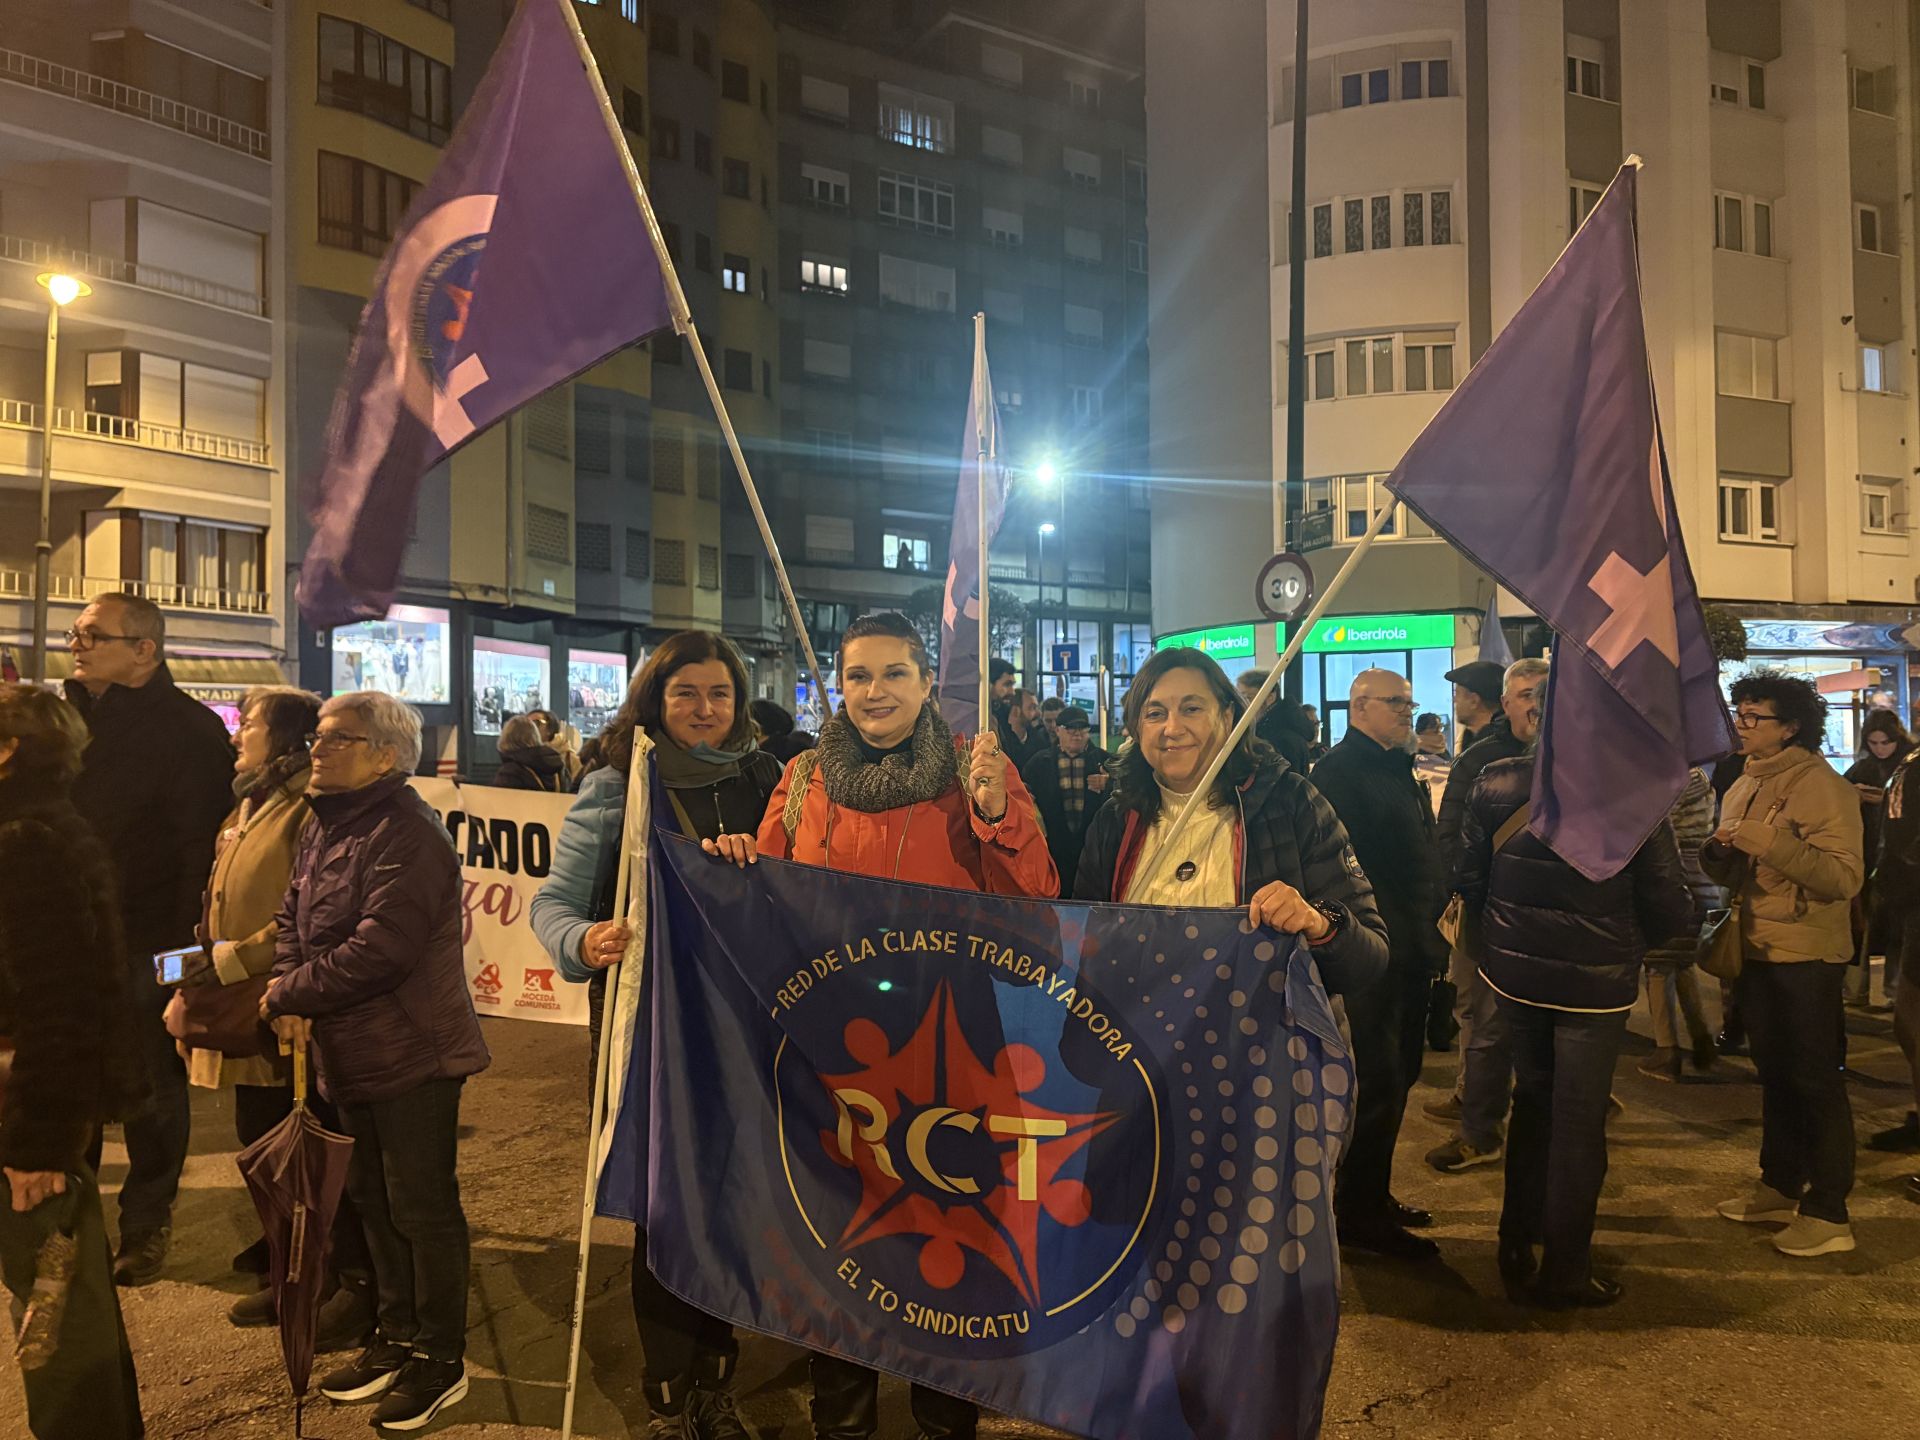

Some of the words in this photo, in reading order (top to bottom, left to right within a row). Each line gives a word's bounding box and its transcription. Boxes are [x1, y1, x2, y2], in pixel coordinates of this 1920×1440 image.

[1271, 577, 1300, 599] 30
[1206, 636, 1249, 650] Iberdrola
[1348, 627, 1407, 641] Iberdrola
[514, 1000, 561, 1010] COMUNISTA
[776, 969, 814, 1010] RED
[811, 949, 843, 979] DE
[845, 937, 877, 963] LA
[883, 930, 958, 954] CLASE
[967, 935, 1133, 1061] TRABAYADORA
[832, 1088, 1067, 1201] RCT
[837, 1257, 861, 1290] EL
[867, 1279, 899, 1312] TO
[902, 1301, 1030, 1339] SINDICATU
